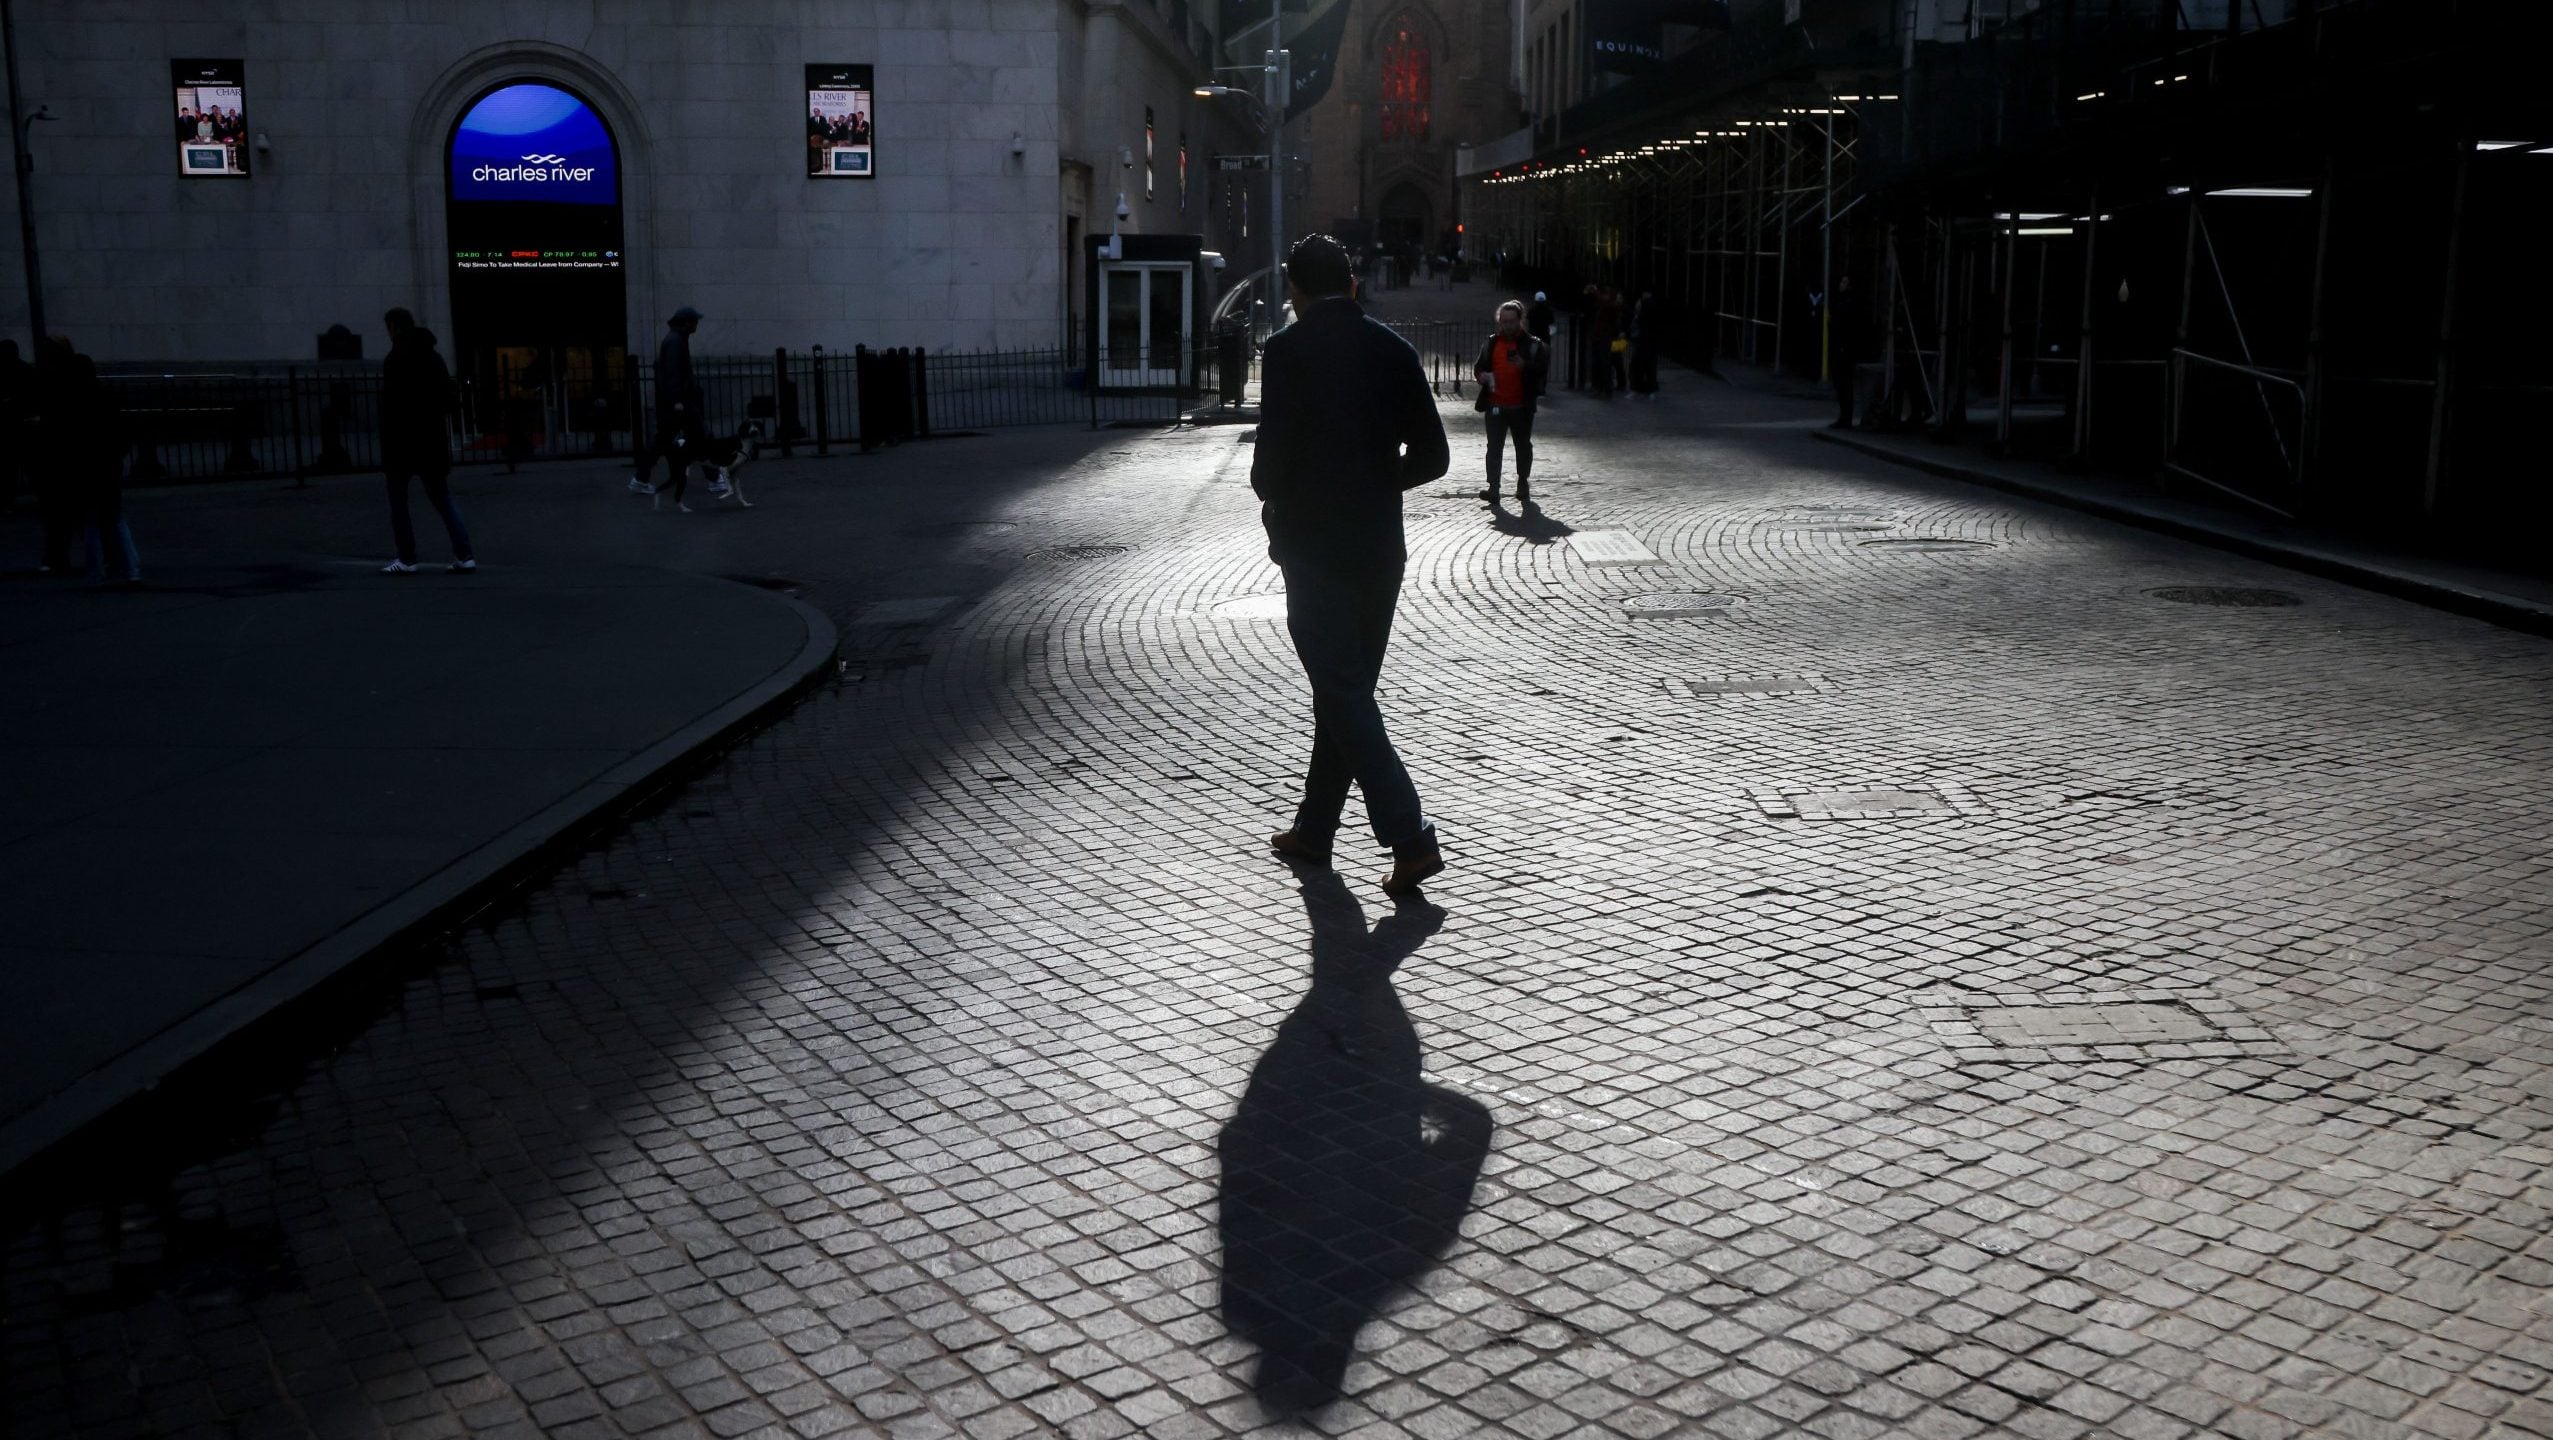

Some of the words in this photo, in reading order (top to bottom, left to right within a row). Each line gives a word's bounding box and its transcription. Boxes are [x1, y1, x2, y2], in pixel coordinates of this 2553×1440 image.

[1596, 40, 1661, 59] EQUINOX
[472, 164, 548, 181] charles
[551, 164, 595, 181] river
[573, 261, 603, 269] Company
